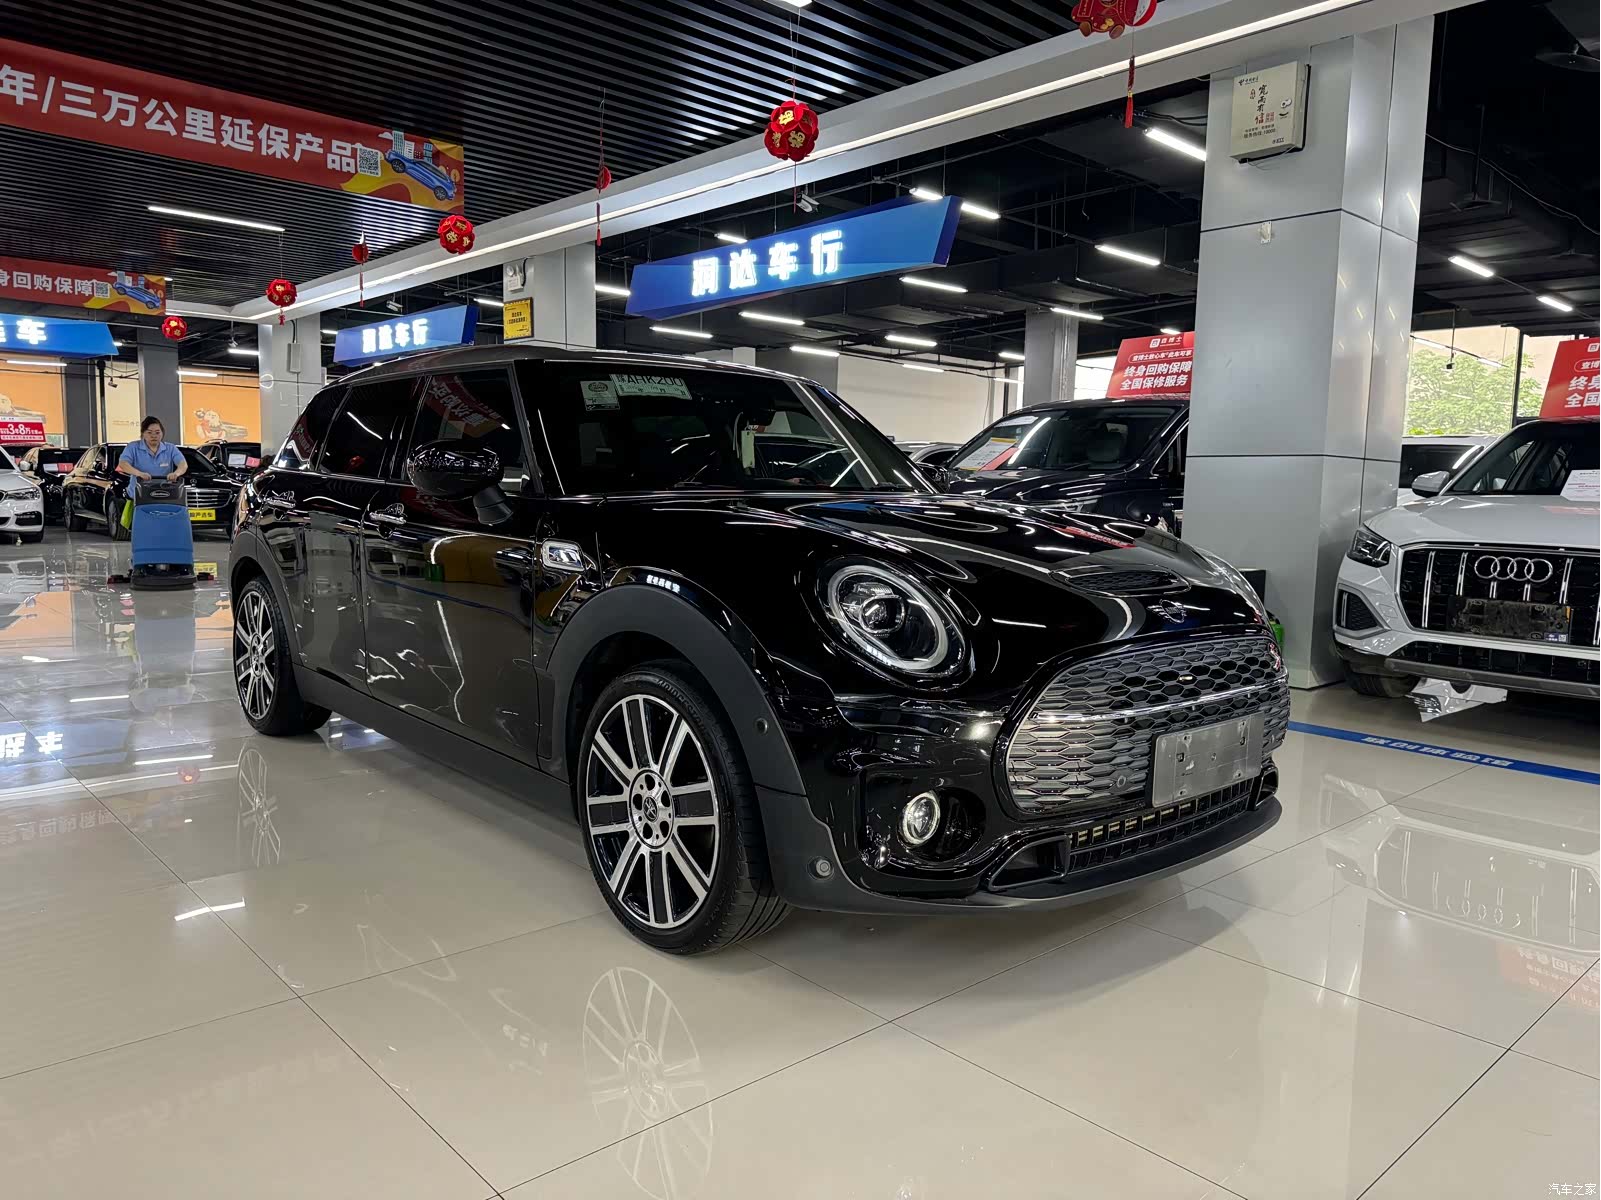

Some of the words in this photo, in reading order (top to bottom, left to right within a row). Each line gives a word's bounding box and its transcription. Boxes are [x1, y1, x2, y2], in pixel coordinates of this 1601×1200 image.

[0, 63, 356, 174] 年/三万公里延保产品
[1123, 360, 1193, 377] 终身回购保障
[1120, 374, 1189, 391] 全国保修服务
